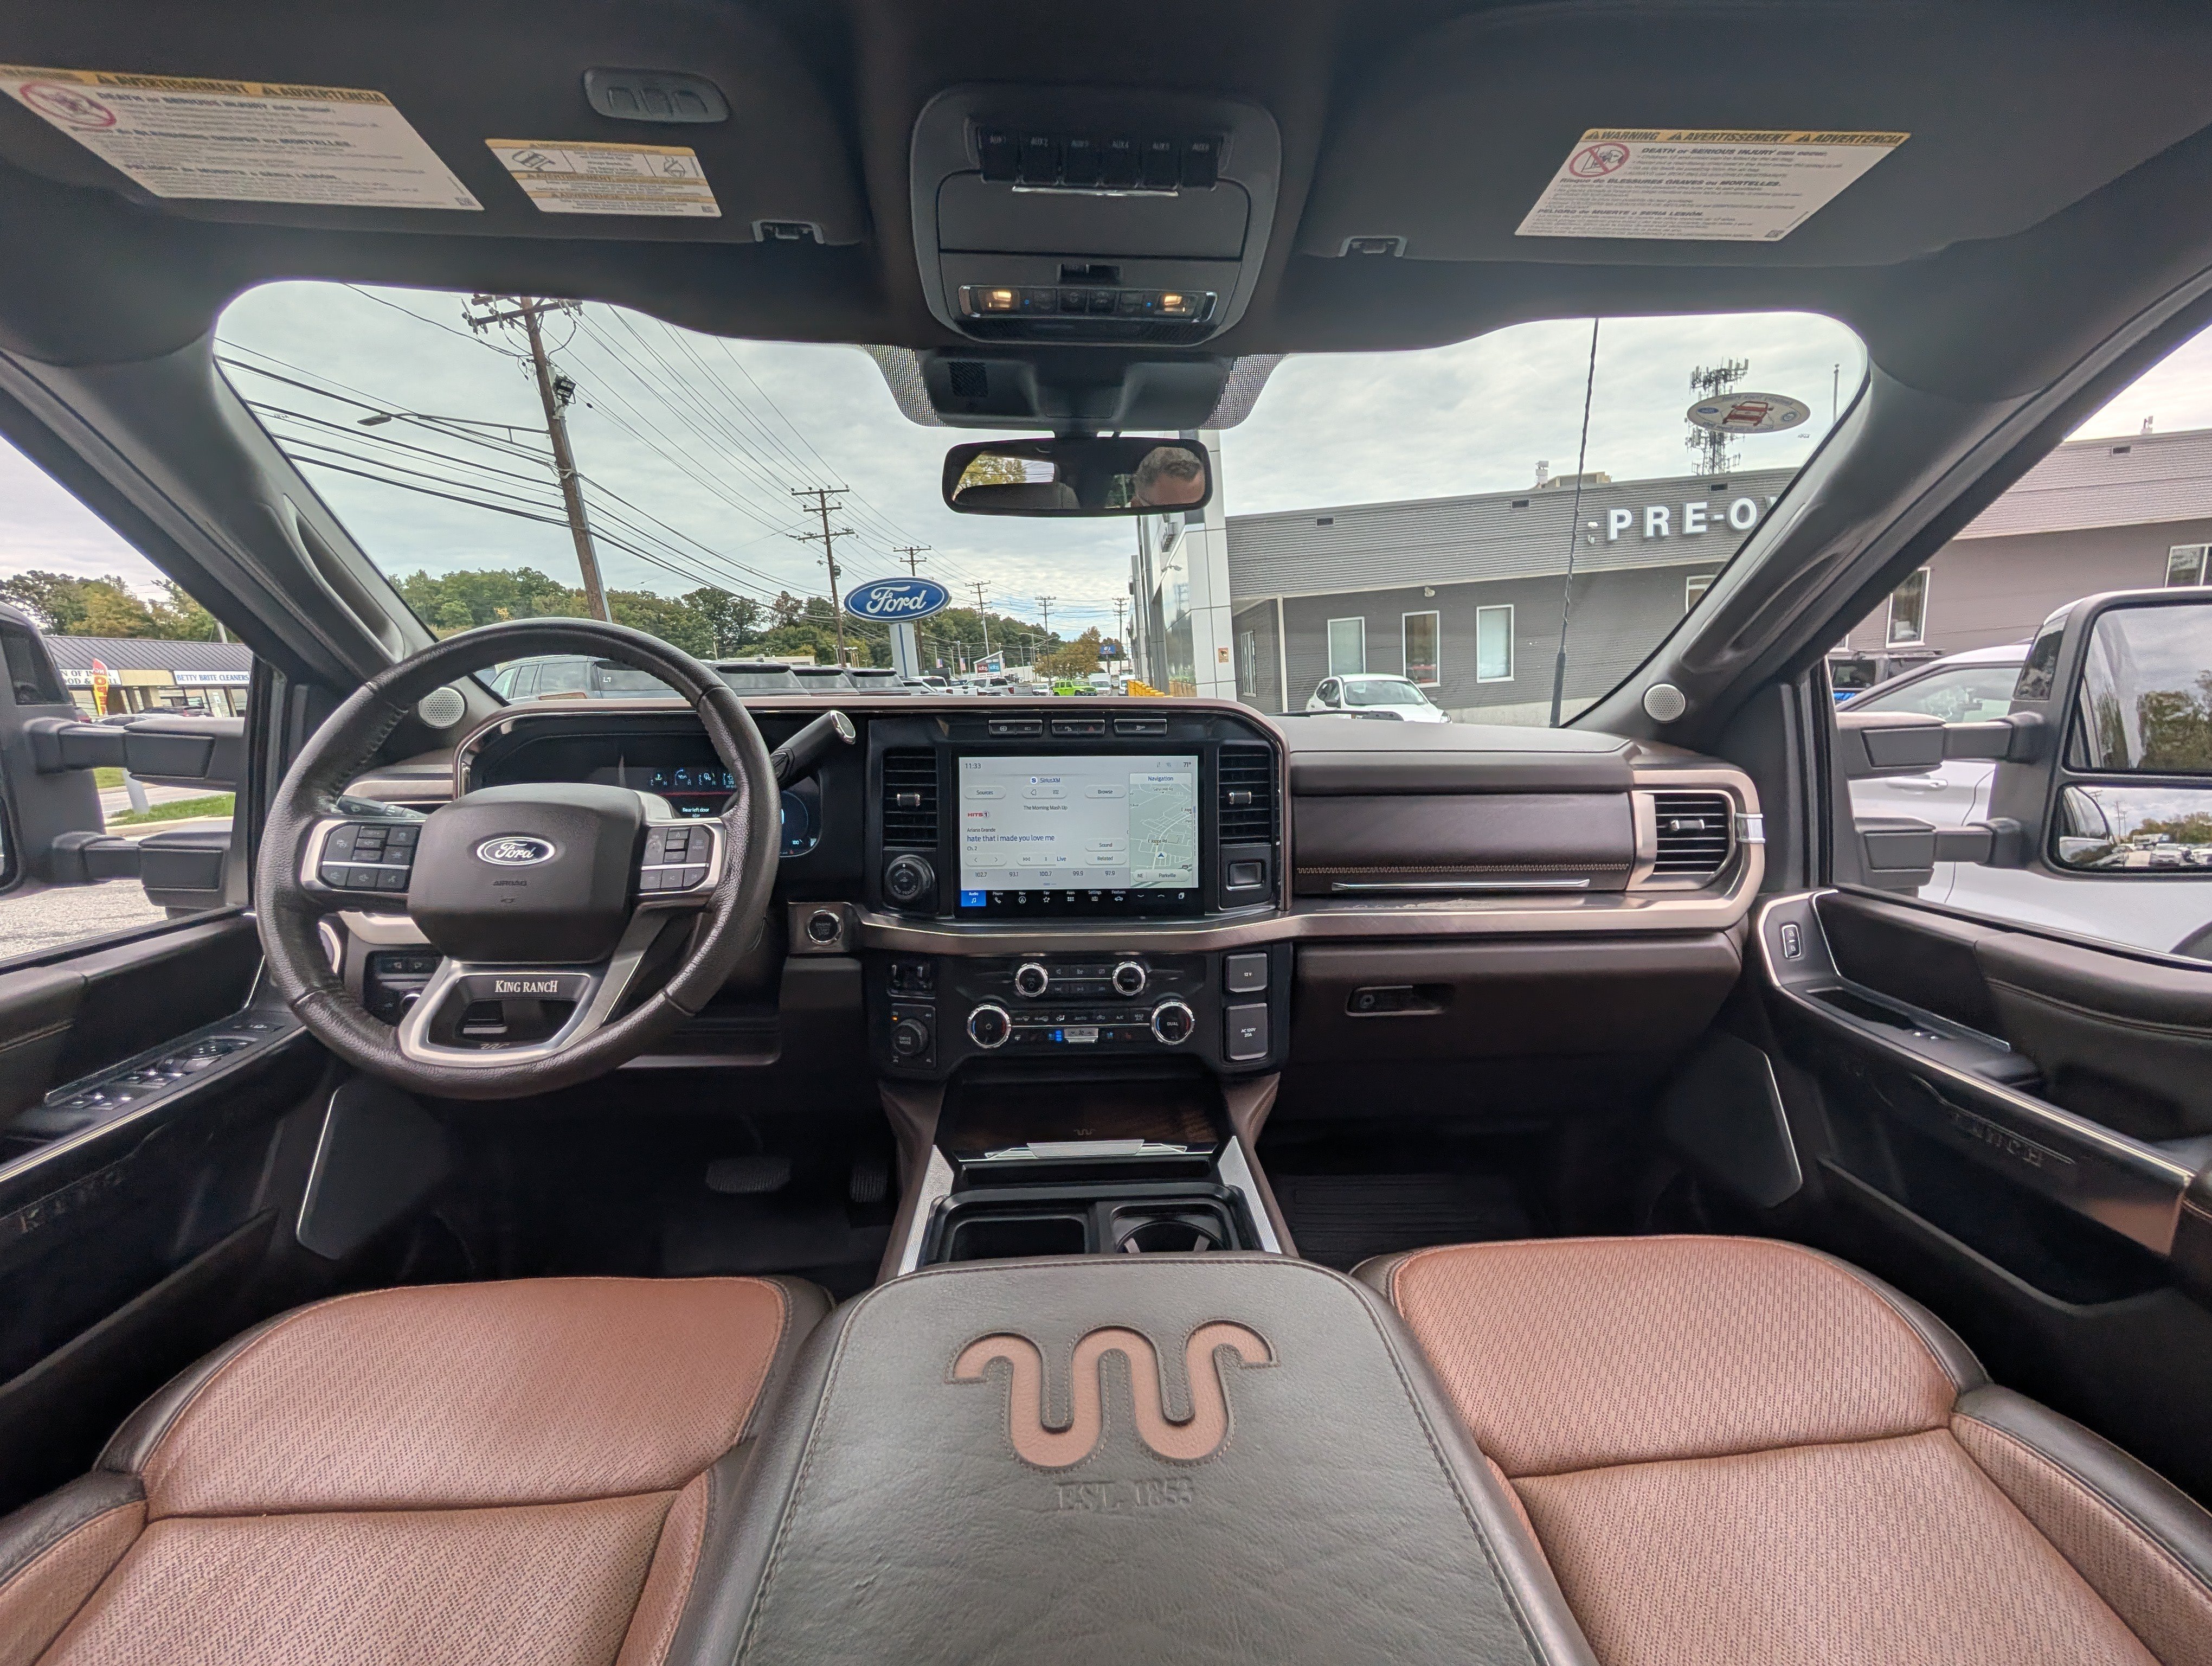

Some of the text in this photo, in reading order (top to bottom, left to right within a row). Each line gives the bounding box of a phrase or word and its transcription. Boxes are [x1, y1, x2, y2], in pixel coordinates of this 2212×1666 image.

[1600, 131, 1905, 144] WARNING AVERTISSEMENT ADVERTENCIA
[1607, 495, 1779, 541] PRE-O
[866, 585, 927, 613] Ford
[494, 842, 536, 858] Ford
[494, 980, 558, 992] KING RANCH
[1135, 1476, 1192, 1507] 1853
